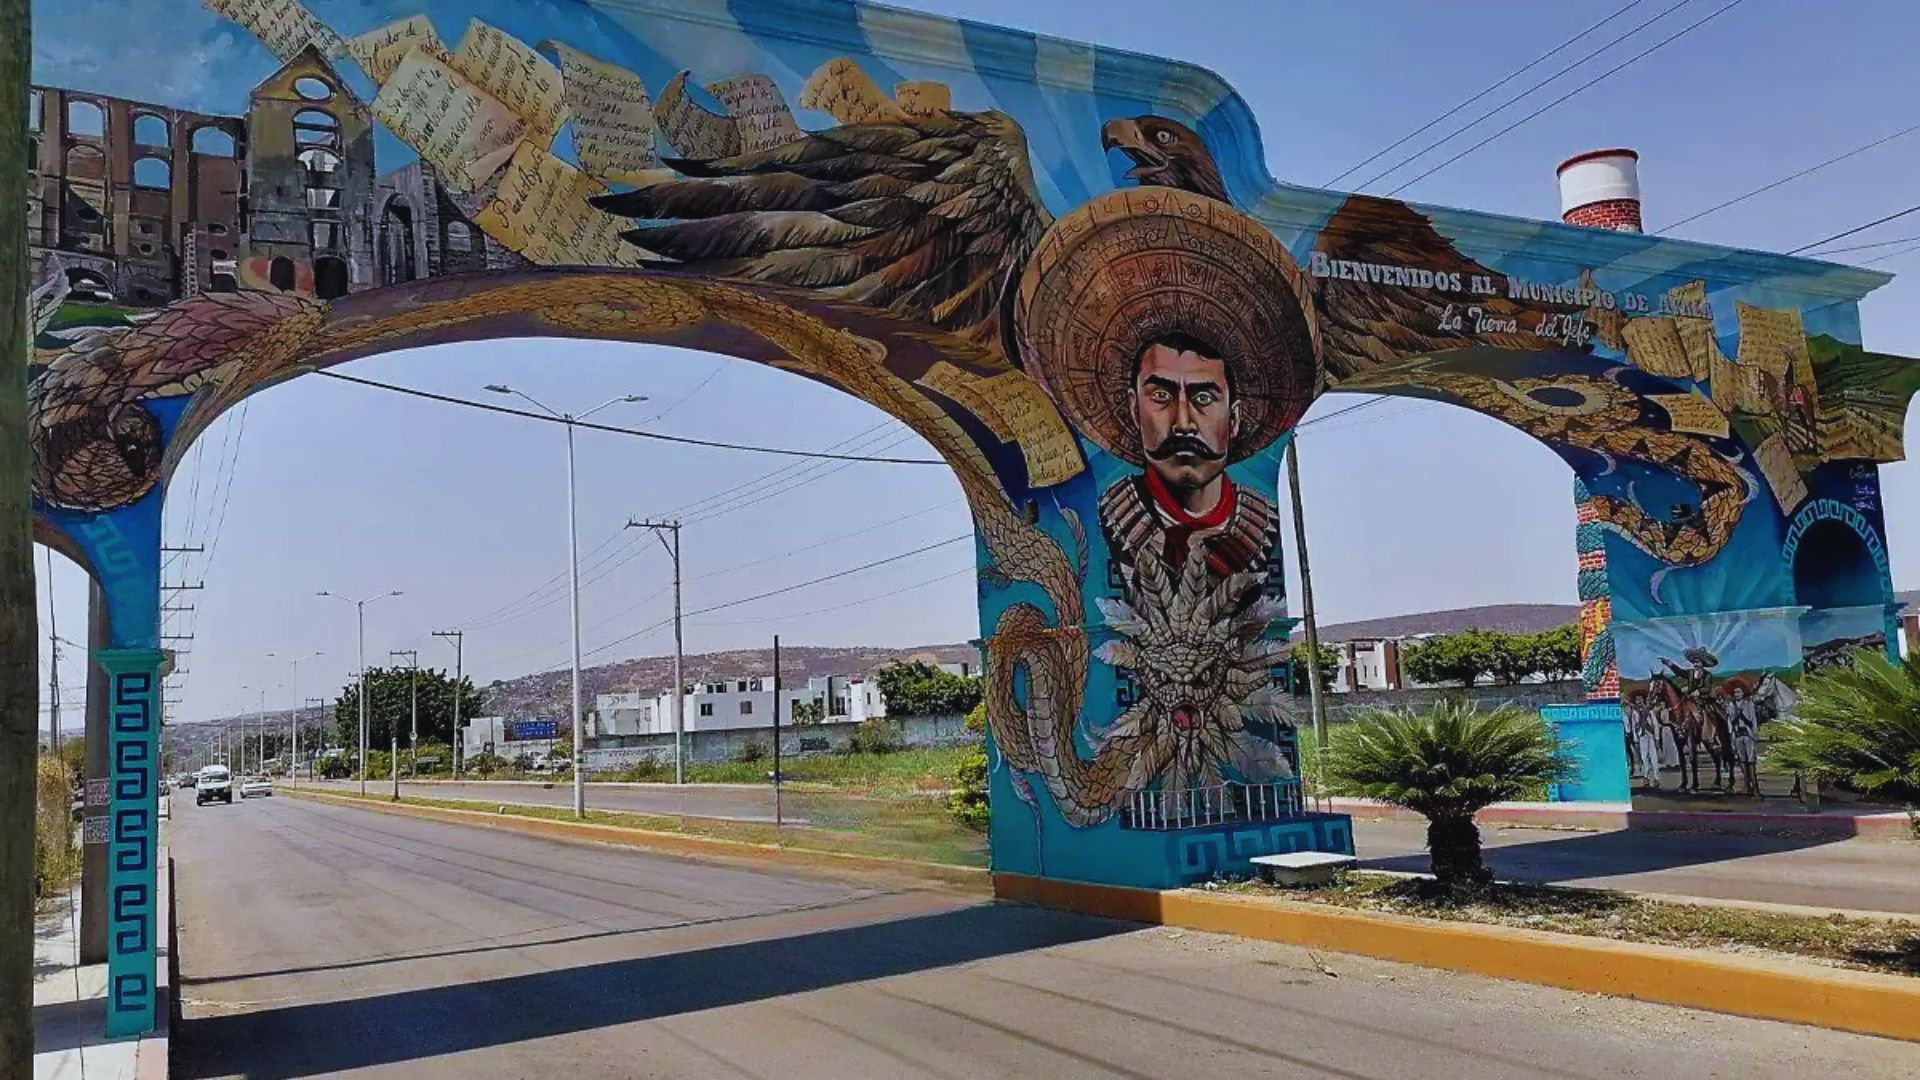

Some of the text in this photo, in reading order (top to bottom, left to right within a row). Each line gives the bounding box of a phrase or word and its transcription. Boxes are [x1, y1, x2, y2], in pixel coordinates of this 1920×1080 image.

[1311, 251, 1462, 293] BIENVENIDOS
[1470, 275, 1497, 296] AL
[1506, 275, 1616, 310] MUNICIPIO
[1624, 291, 1649, 313] DE
[1437, 303, 1590, 347] La Tierra del Jefe
